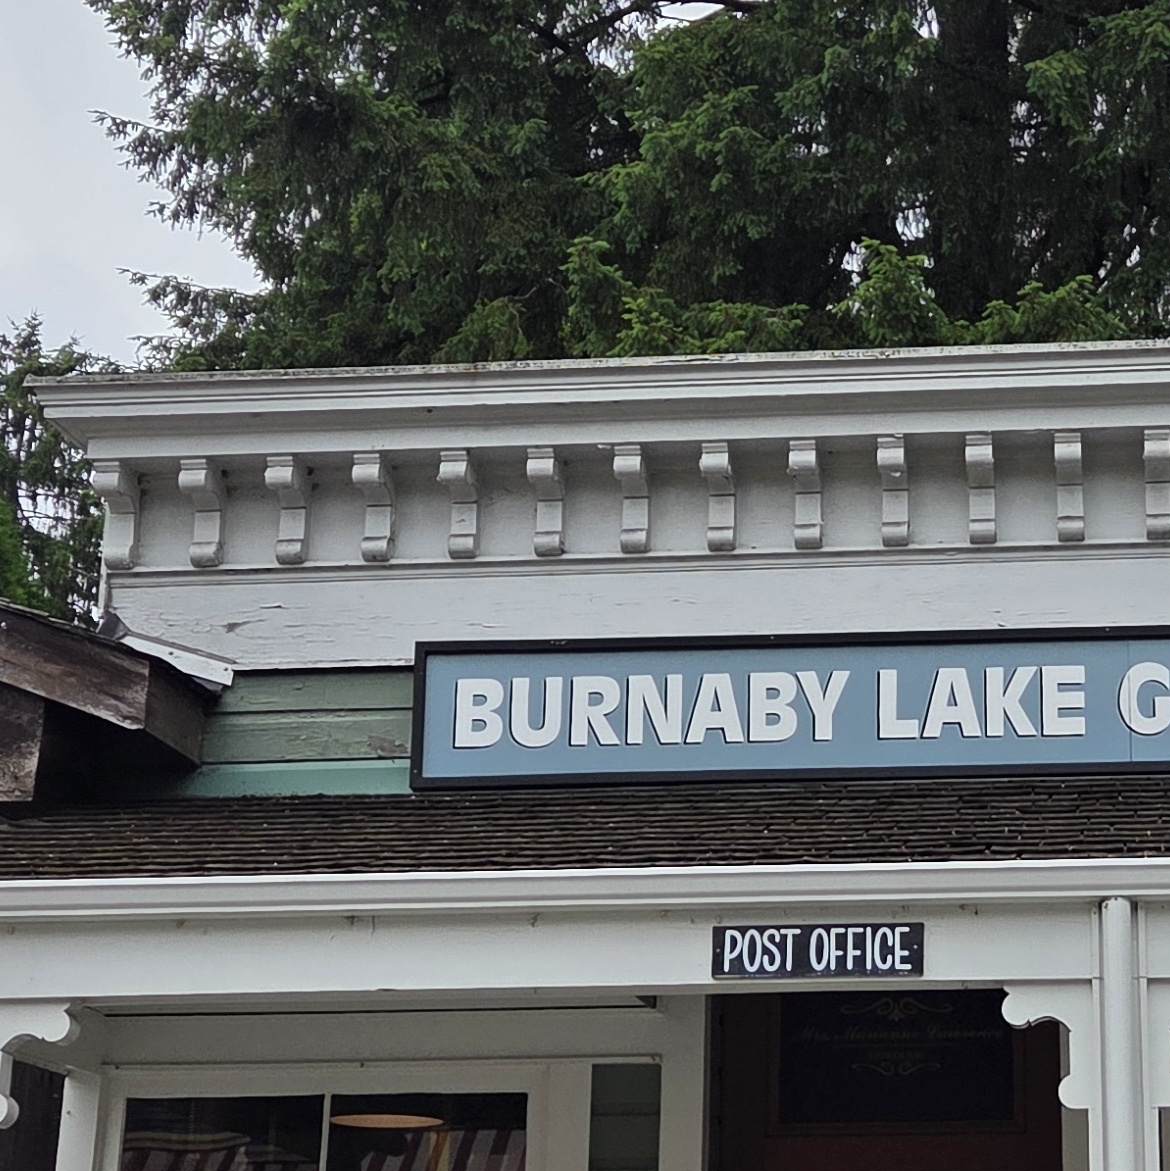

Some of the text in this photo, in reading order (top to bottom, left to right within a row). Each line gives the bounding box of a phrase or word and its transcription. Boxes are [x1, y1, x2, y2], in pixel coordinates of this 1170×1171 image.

[453, 669, 850, 749] BURNABY
[876, 665, 1086, 740] LAKE
[723, 926, 912, 973] POST OFFICE
